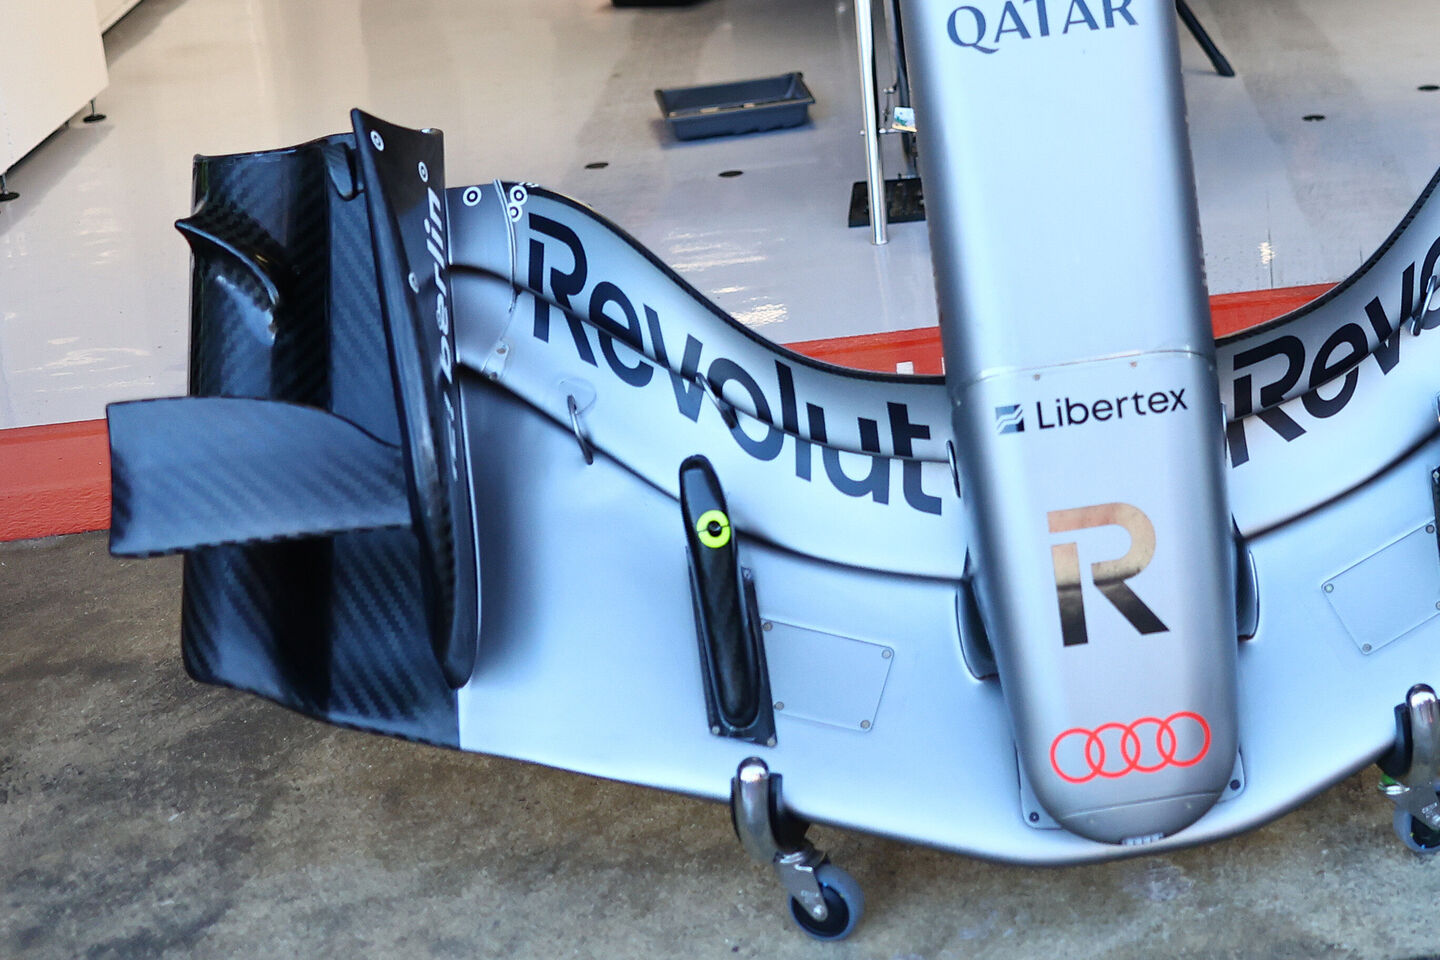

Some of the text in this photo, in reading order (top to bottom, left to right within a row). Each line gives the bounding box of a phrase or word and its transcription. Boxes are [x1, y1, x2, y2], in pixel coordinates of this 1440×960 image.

[424, 187, 453, 386] berlin
[527, 211, 943, 516] Revolut
[1036, 388, 1188, 430] Libertex
